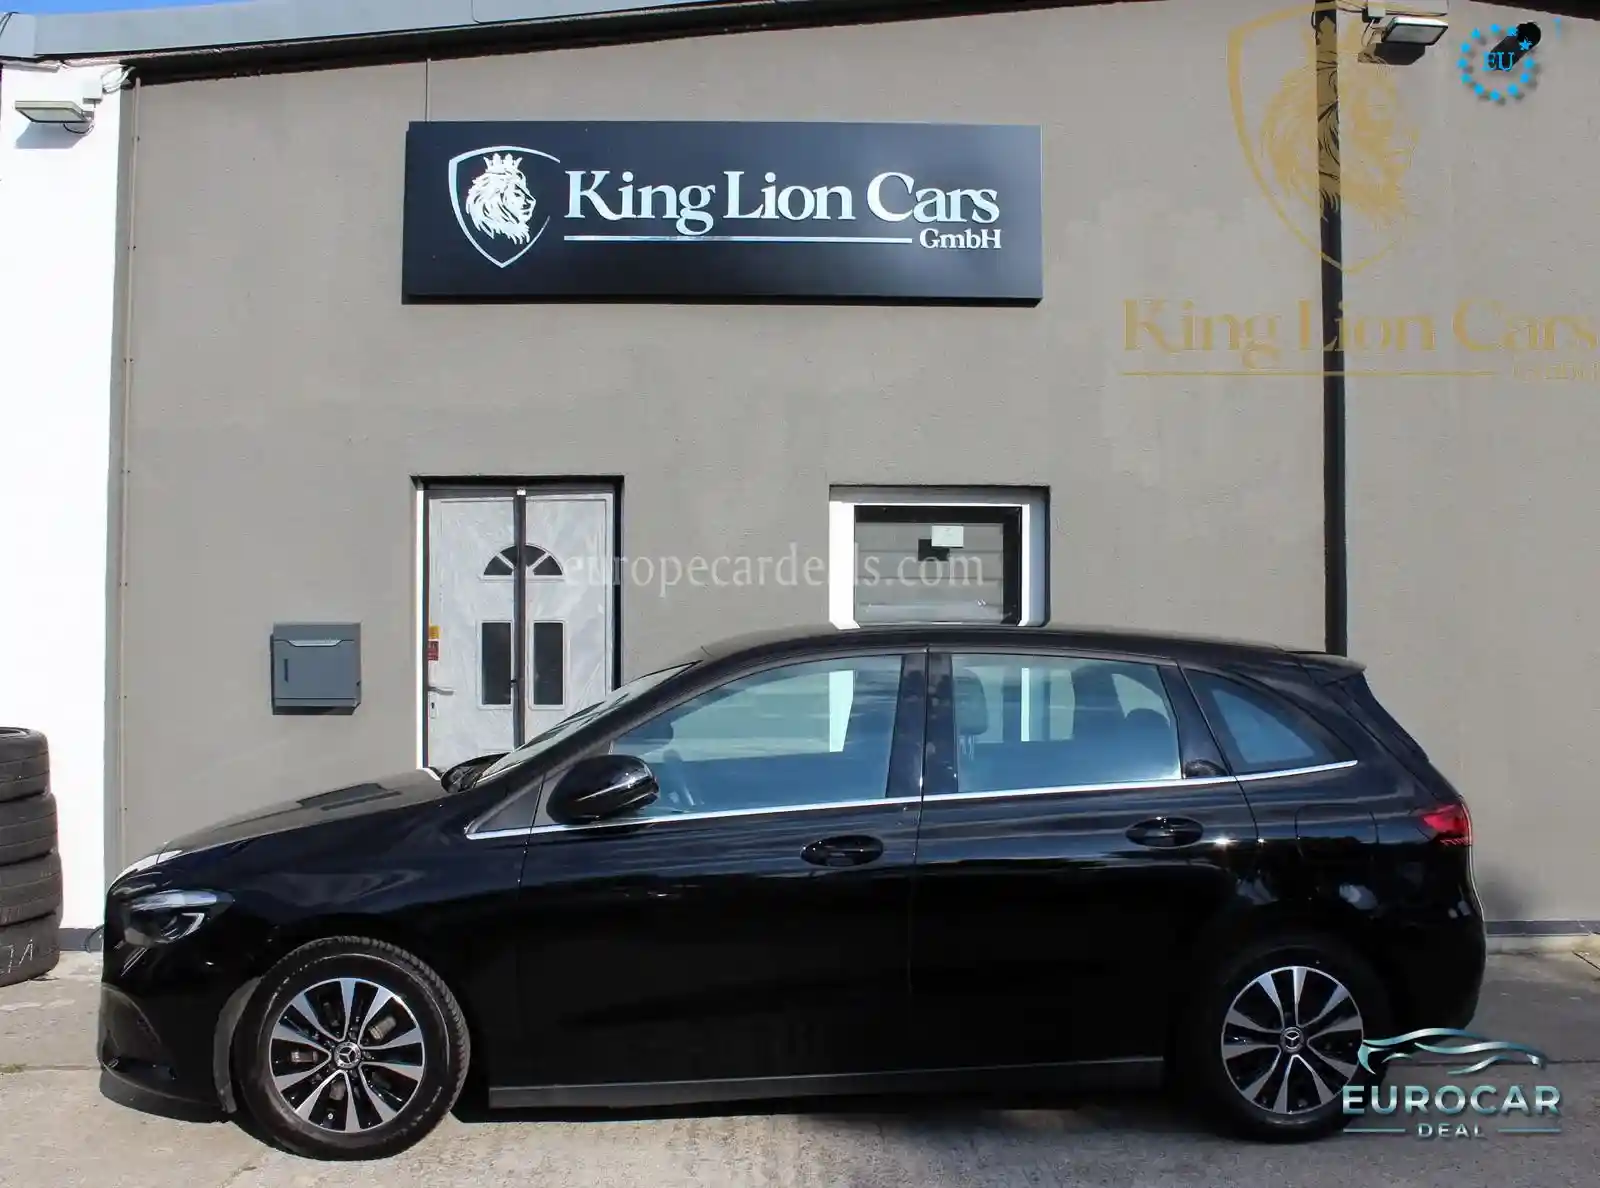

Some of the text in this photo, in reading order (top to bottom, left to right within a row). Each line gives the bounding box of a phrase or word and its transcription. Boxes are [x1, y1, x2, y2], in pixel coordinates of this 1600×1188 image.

[563, 169, 999, 235] King Lion Cars
[919, 228, 1003, 250] GmbH
